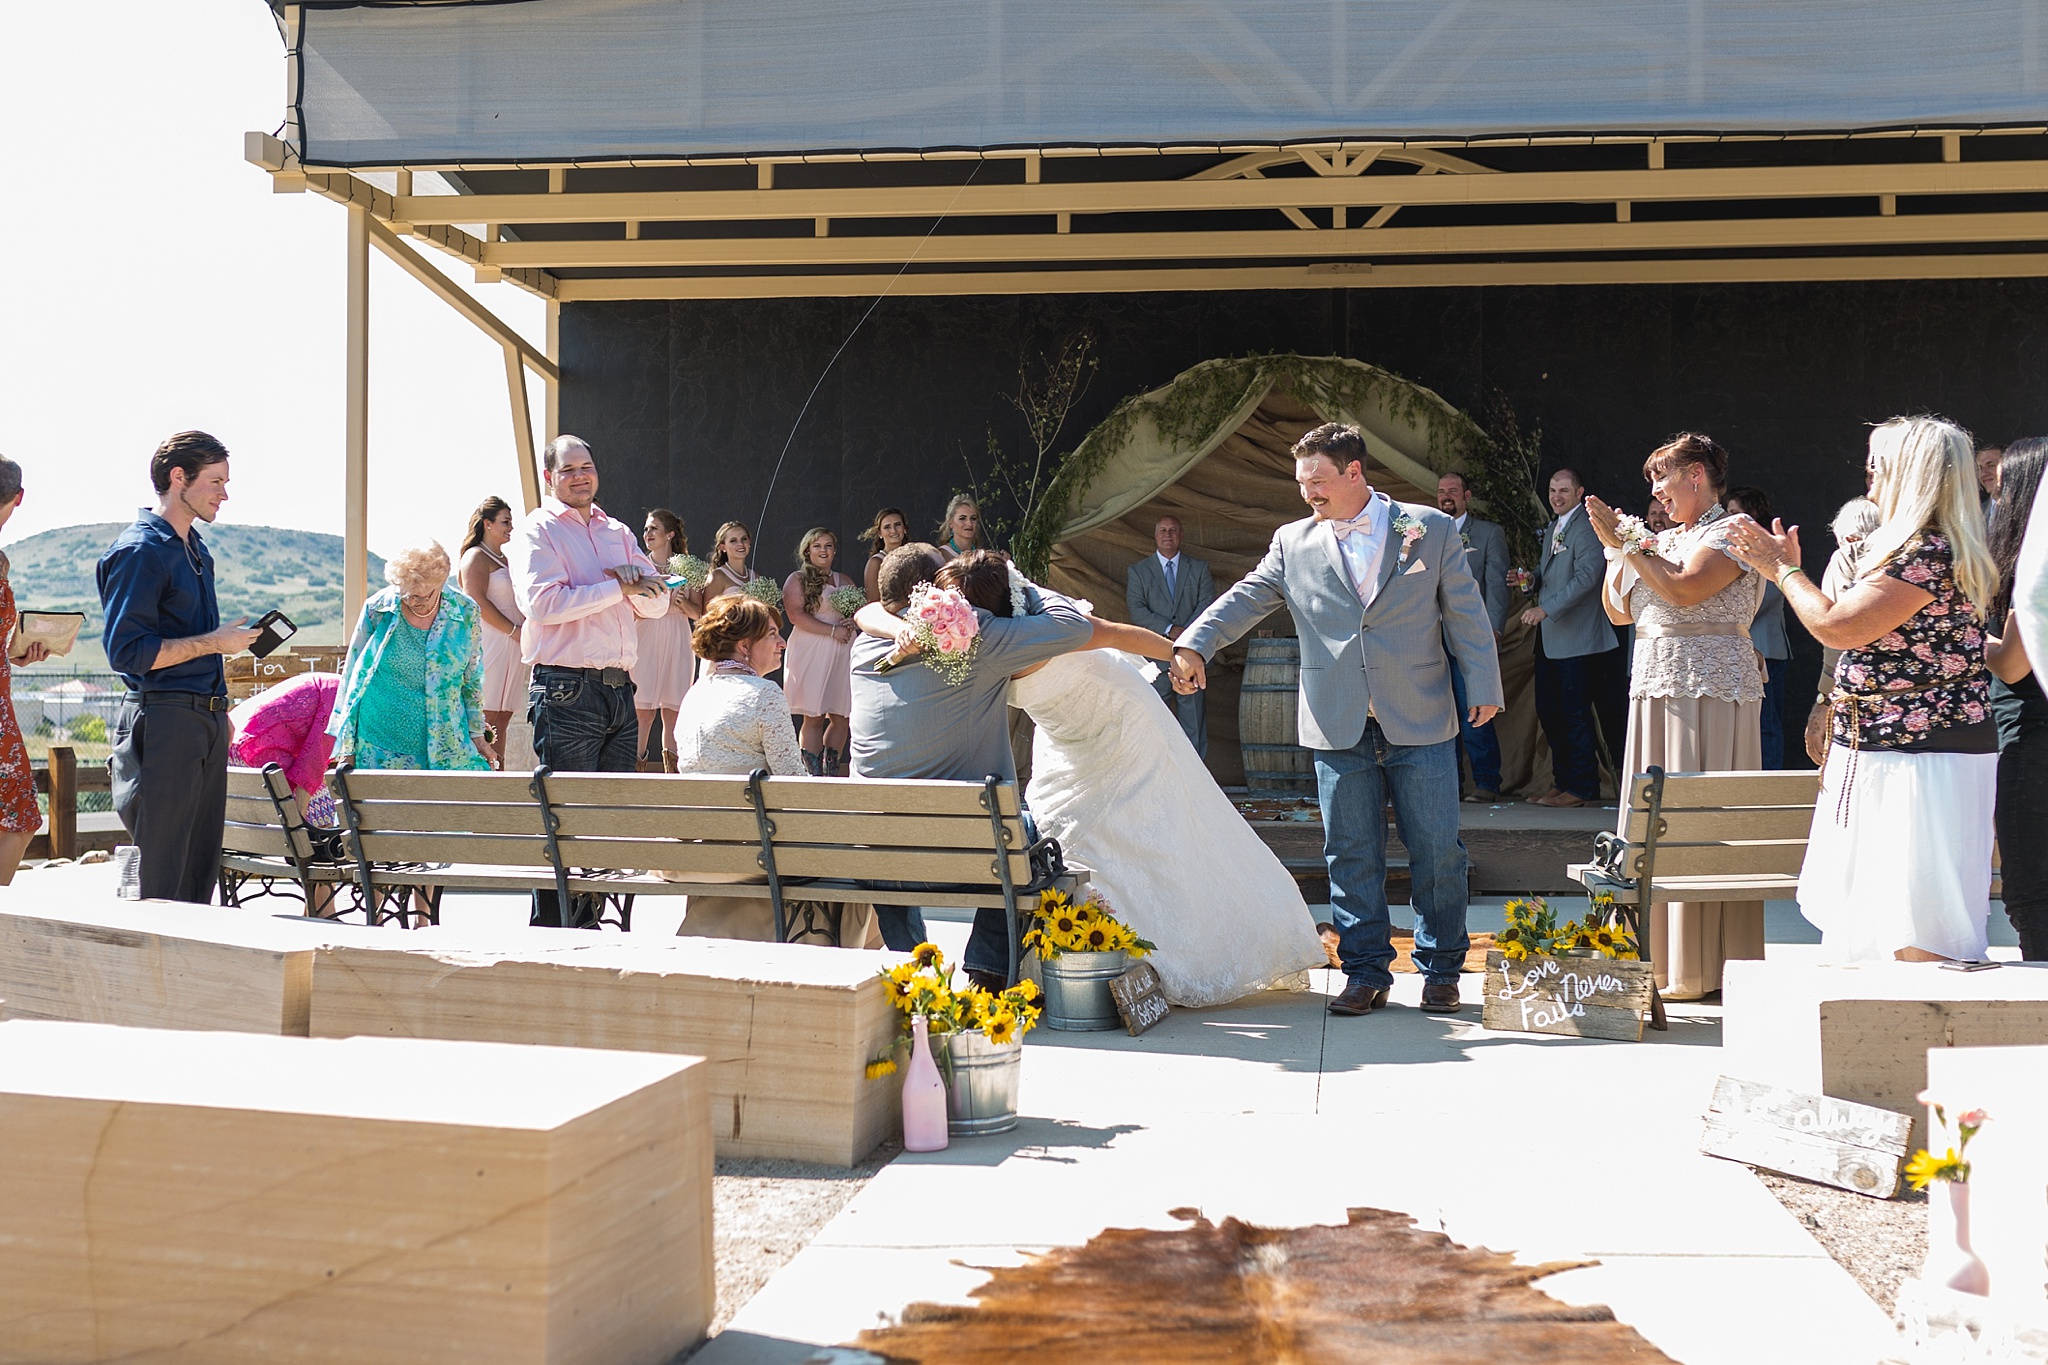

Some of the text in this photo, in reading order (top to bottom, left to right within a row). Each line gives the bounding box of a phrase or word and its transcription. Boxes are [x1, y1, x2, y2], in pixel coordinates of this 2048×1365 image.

[253, 657, 285, 676] For
[1498, 959, 1627, 1002] Love Never
[1519, 991, 1587, 1031] Fails
